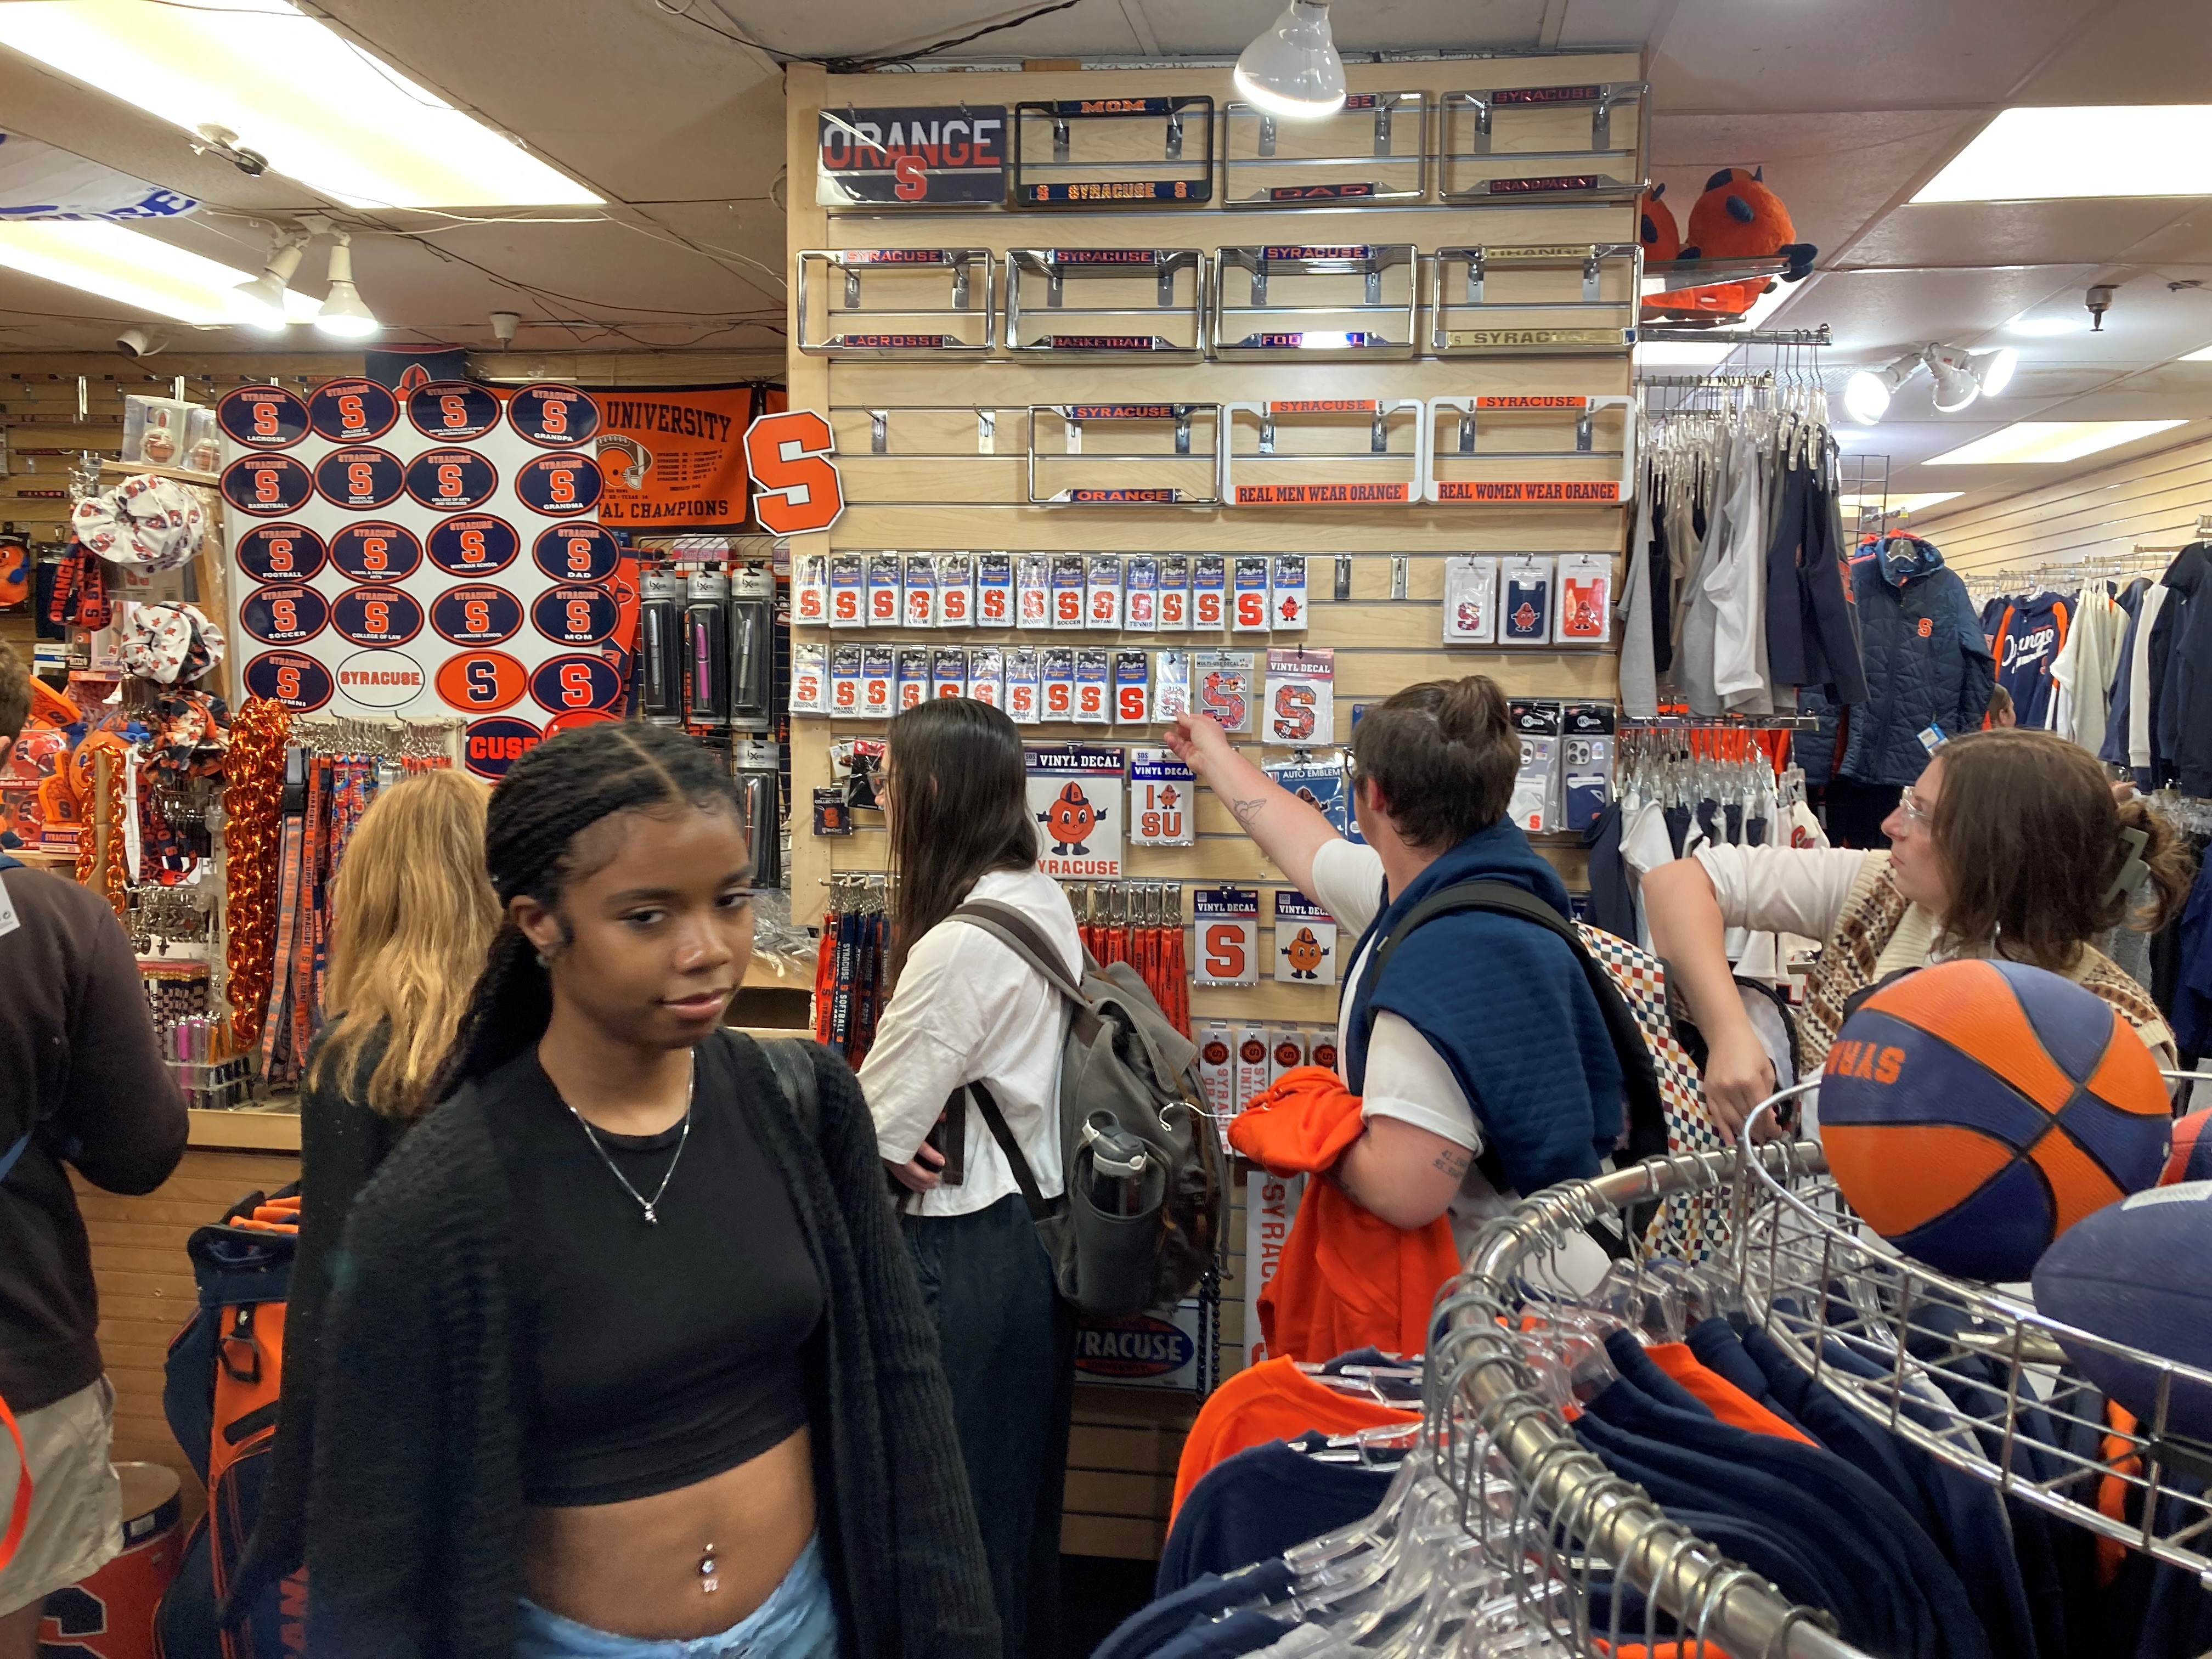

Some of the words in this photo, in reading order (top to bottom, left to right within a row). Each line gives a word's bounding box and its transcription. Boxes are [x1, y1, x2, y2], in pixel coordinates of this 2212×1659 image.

[1081, 99, 1146, 113] MOM
[1496, 87, 1595, 103] SYRACUSE
[823, 120, 1001, 168] ORANGE
[894, 155, 927, 201] S
[1068, 182, 1156, 200] SYRACUSE
[1492, 177, 1594, 191] GRANDPARENT
[1274, 184, 1369, 199] DAD
[846, 250, 940, 262] SYRACUSE
[1057, 251, 1152, 262] SYRACUSE
[1267, 247, 1365, 258] SYRACUSE
[844, 336, 942, 347] LACROSSE
[1053, 337, 1152, 348] BASKETBALL
[1262, 334, 1363, 346] FOOL
[338, 395, 366, 429] S
[440, 395, 467, 428] S
[1077, 406, 1171, 417] SYRACUSE
[1280, 400, 1366, 411] SYRACUSE
[1486, 397, 1576, 407] SYRACUSE
[253, 403, 279, 436] S
[543, 400, 567, 434] S
[607, 401, 731, 442] UNIVERSITY
[534, 433, 573, 442] GRANDPA
[255, 470, 280, 502] S
[348, 462, 373, 495] S
[438, 464, 463, 497] S
[743, 408, 845, 538] S
[550, 470, 575, 503] S
[1077, 490, 1170, 501] ORANGE
[1239, 487, 1272, 503] REAL
[1277, 486, 1305, 501] MEN
[1309, 484, 1347, 500] WEAR
[1350, 483, 1402, 500] ORANGE
[1439, 484, 1472, 500] REAL
[1476, 484, 1521, 500] WOMEN
[1525, 483, 1562, 499] WEAR
[1565, 483, 1615, 499] ORANGE
[631, 500, 729, 518] CHAMPIONS
[269, 539, 294, 571] S
[363, 538, 388, 571] S
[460, 530, 486, 563] S
[567, 538, 591, 571] S
[272, 599, 297, 631] S
[465, 600, 489, 633] S
[566, 600, 591, 633] S
[836, 591, 856, 618] S
[874, 590, 893, 617] S
[945, 591, 965, 618] S
[984, 590, 1005, 617] S
[1059, 592, 1079, 619] S
[1132, 594, 1152, 620] S
[1199, 594, 1220, 621] S
[1239, 593, 1262, 625] S
[365, 601, 388, 634] S
[1918, 618, 1932, 636] S
[268, 631, 307, 639] SOCCER
[340, 672, 420, 685] SYRACUSE
[465, 659, 498, 703] S
[1271, 662, 1299, 672] VINYL
[1301, 664, 1330, 674] DECAL
[276, 667, 300, 699] S
[560, 663, 593, 707] S
[837, 681, 854, 706] S
[868, 680, 886, 704] S
[269, 697, 307, 707] UMNI
[1048, 684, 1068, 710] S
[1081, 687, 1101, 712] S
[1120, 687, 1144, 719] S
[1281, 725, 1292, 735] SU
[1040, 755, 1078, 767] VINYL
[1081, 755, 1120, 768] DECAL
[1135, 766, 1162, 775] VINYL
[1164, 768, 1194, 776] DECAL
[1283, 770, 1305, 778] AUTO
[1307, 769, 1340, 777] EMBLEM
[1146, 785, 1154, 809] I
[1142, 811, 1181, 837] SU
[1037, 860, 1119, 875] YRACUSE
[1198, 903, 1225, 911] VINYL
[1227, 904, 1256, 912] DECAL
[1279, 905, 1306, 915] VINYL
[840, 943, 850, 980] SYRACUSE
[1205, 924, 1245, 977] S
[837, 995, 848, 1032] SOFTBALL
[1076, 1331, 1183, 1362] YRACUSE
